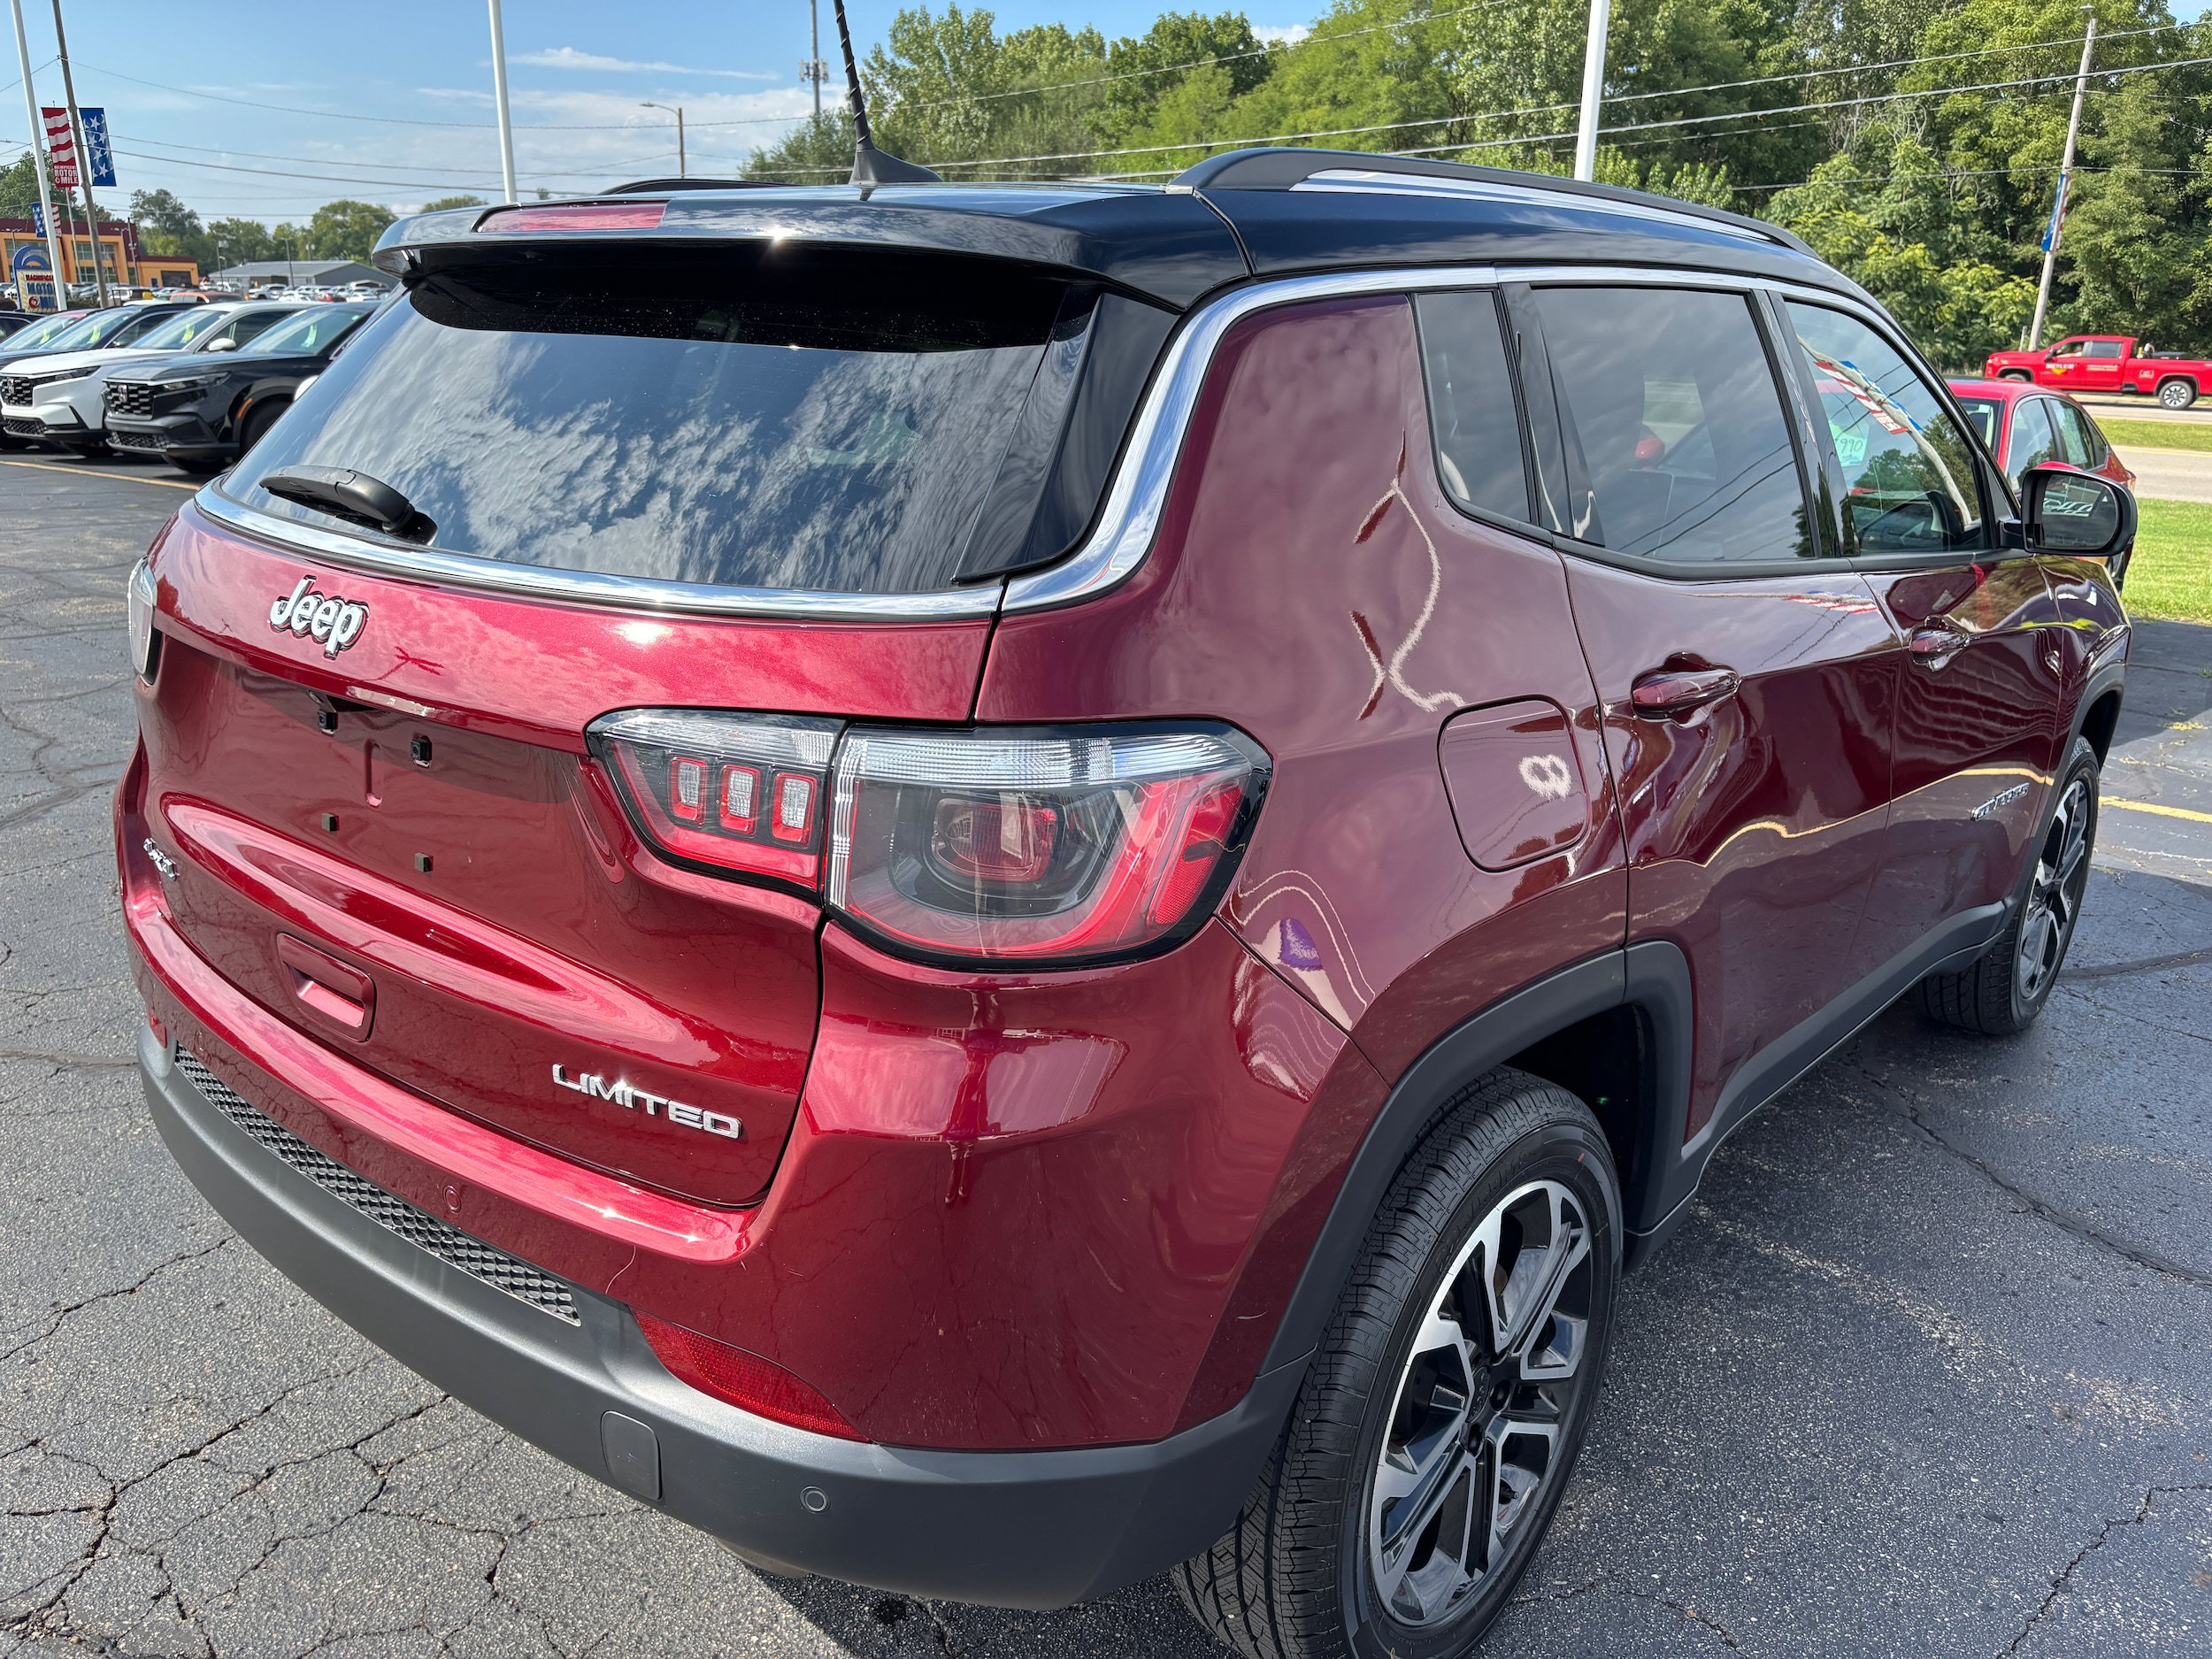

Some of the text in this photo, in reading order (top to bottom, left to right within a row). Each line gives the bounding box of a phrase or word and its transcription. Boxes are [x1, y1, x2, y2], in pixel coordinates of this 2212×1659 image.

[27, 283, 54, 295] MOTO
[270, 574, 370, 661] Jeep
[552, 1064, 743, 1140] LIMITED
